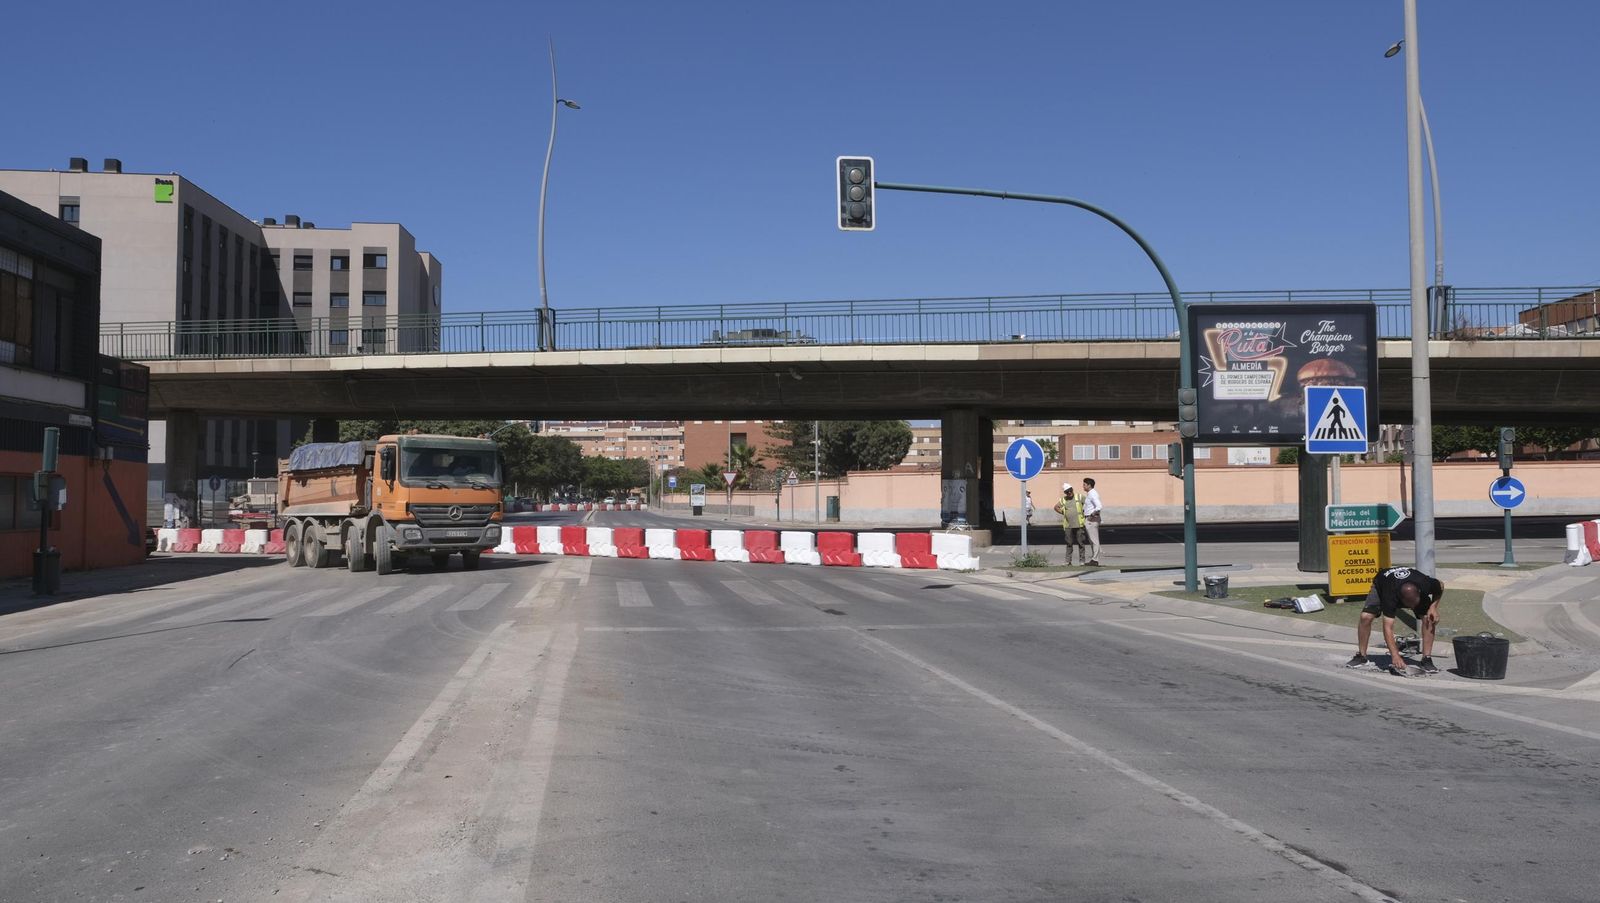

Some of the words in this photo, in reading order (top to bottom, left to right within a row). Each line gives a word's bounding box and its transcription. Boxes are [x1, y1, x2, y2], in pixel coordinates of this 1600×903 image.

[1318, 320, 1336, 334] The
[1300, 330, 1352, 344] Champions
[1217, 328, 1284, 361] Ruta
[1309, 342, 1345, 356] Burger
[1231, 362, 1262, 370] ALMERÍA
[1331, 509, 1356, 517] avenida
[1331, 518, 1386, 527] Mediterráneo
[1344, 558, 1376, 566] CORTADA
